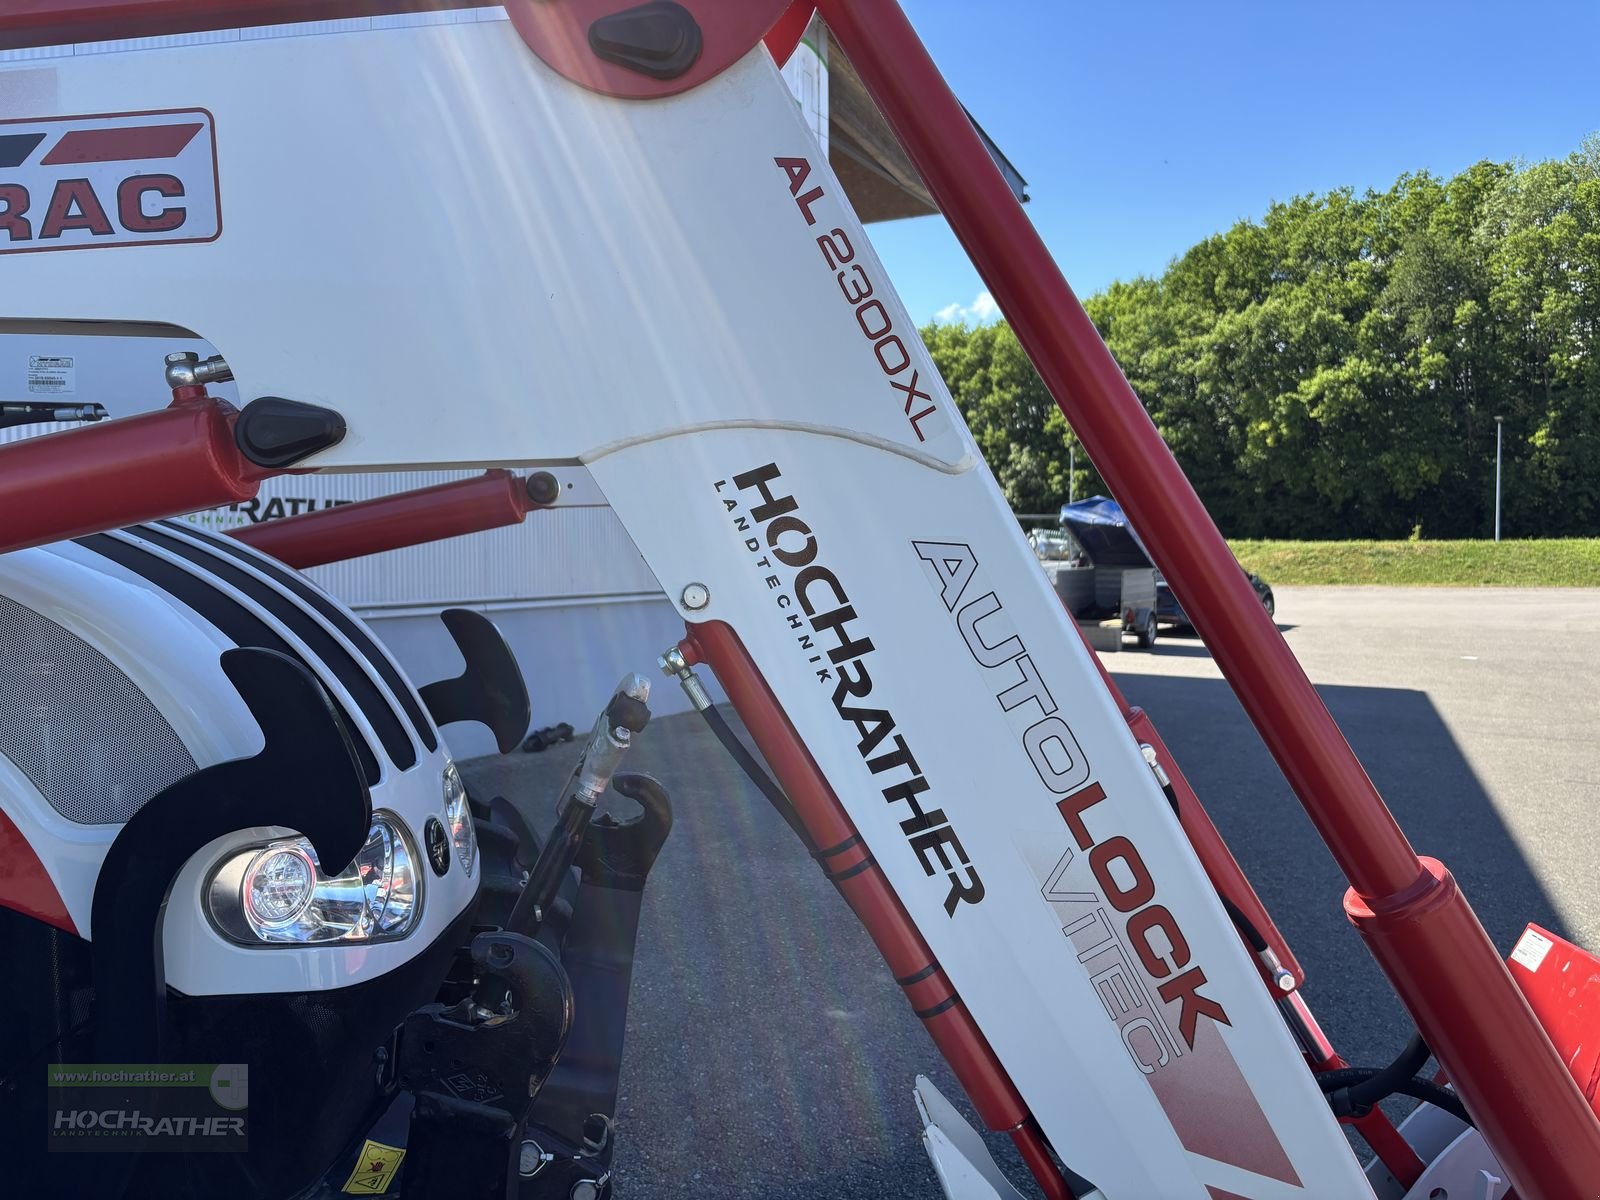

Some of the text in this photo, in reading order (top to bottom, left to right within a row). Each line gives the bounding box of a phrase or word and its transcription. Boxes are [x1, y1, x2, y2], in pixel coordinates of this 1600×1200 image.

[773, 157, 937, 443] AL 2300XL
[713, 479, 833, 684] LANDTECHNIK
[732, 462, 986, 919] HOCHRATHER
[911, 540, 1233, 1052] AUTOLOCK
[1041, 847, 1183, 1075] VITEC
